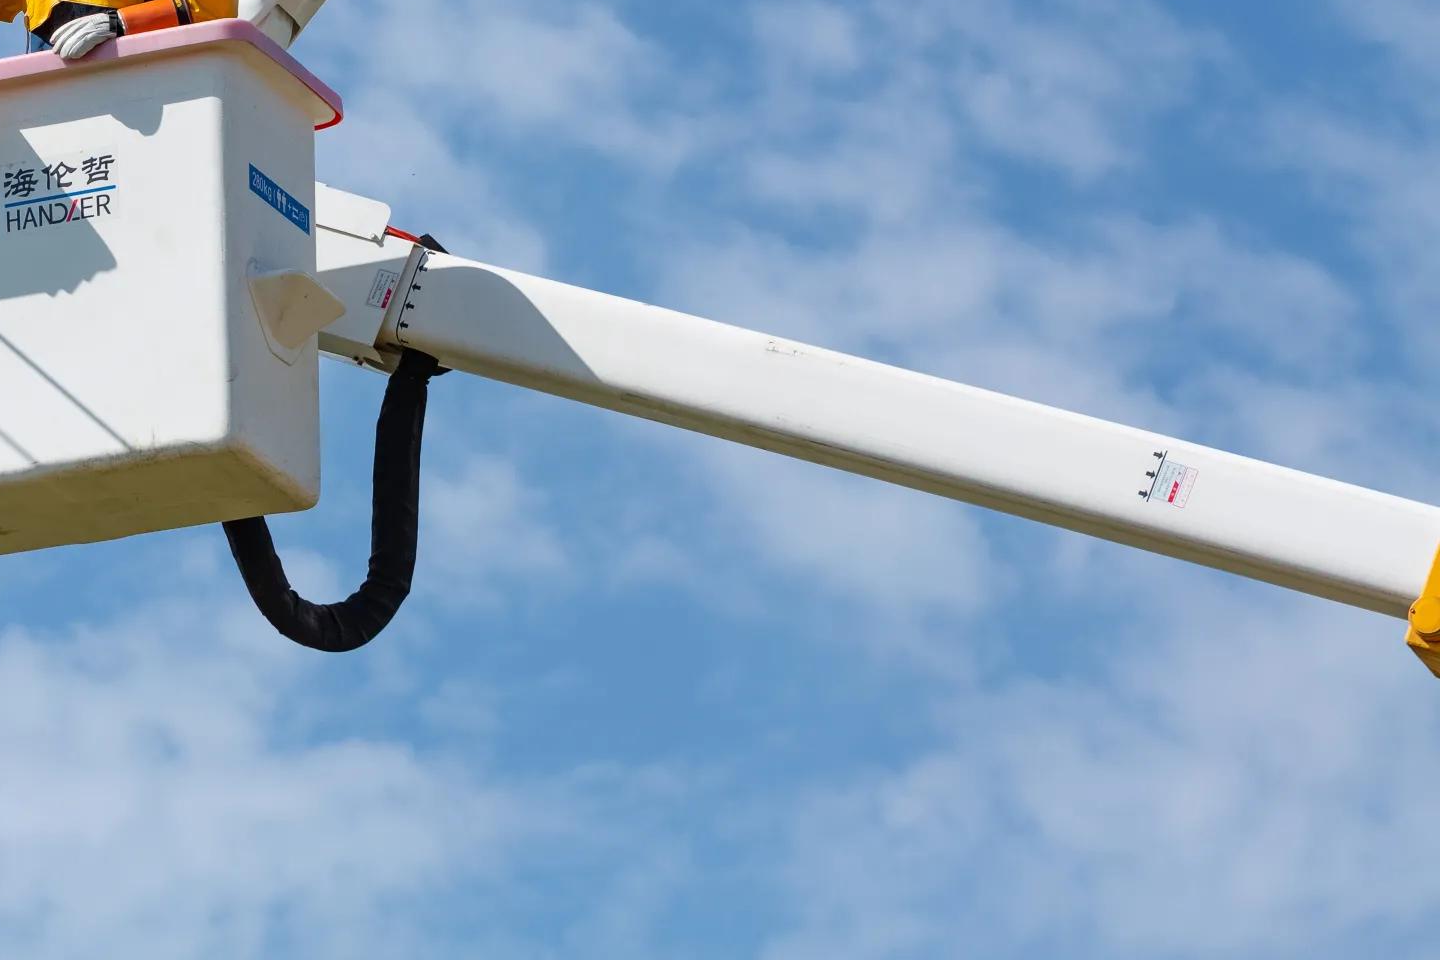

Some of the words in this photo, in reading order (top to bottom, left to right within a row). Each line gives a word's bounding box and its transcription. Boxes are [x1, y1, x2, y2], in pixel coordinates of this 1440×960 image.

[4, 154, 115, 198] 海伦哲
[6, 194, 111, 232] HANDLER
